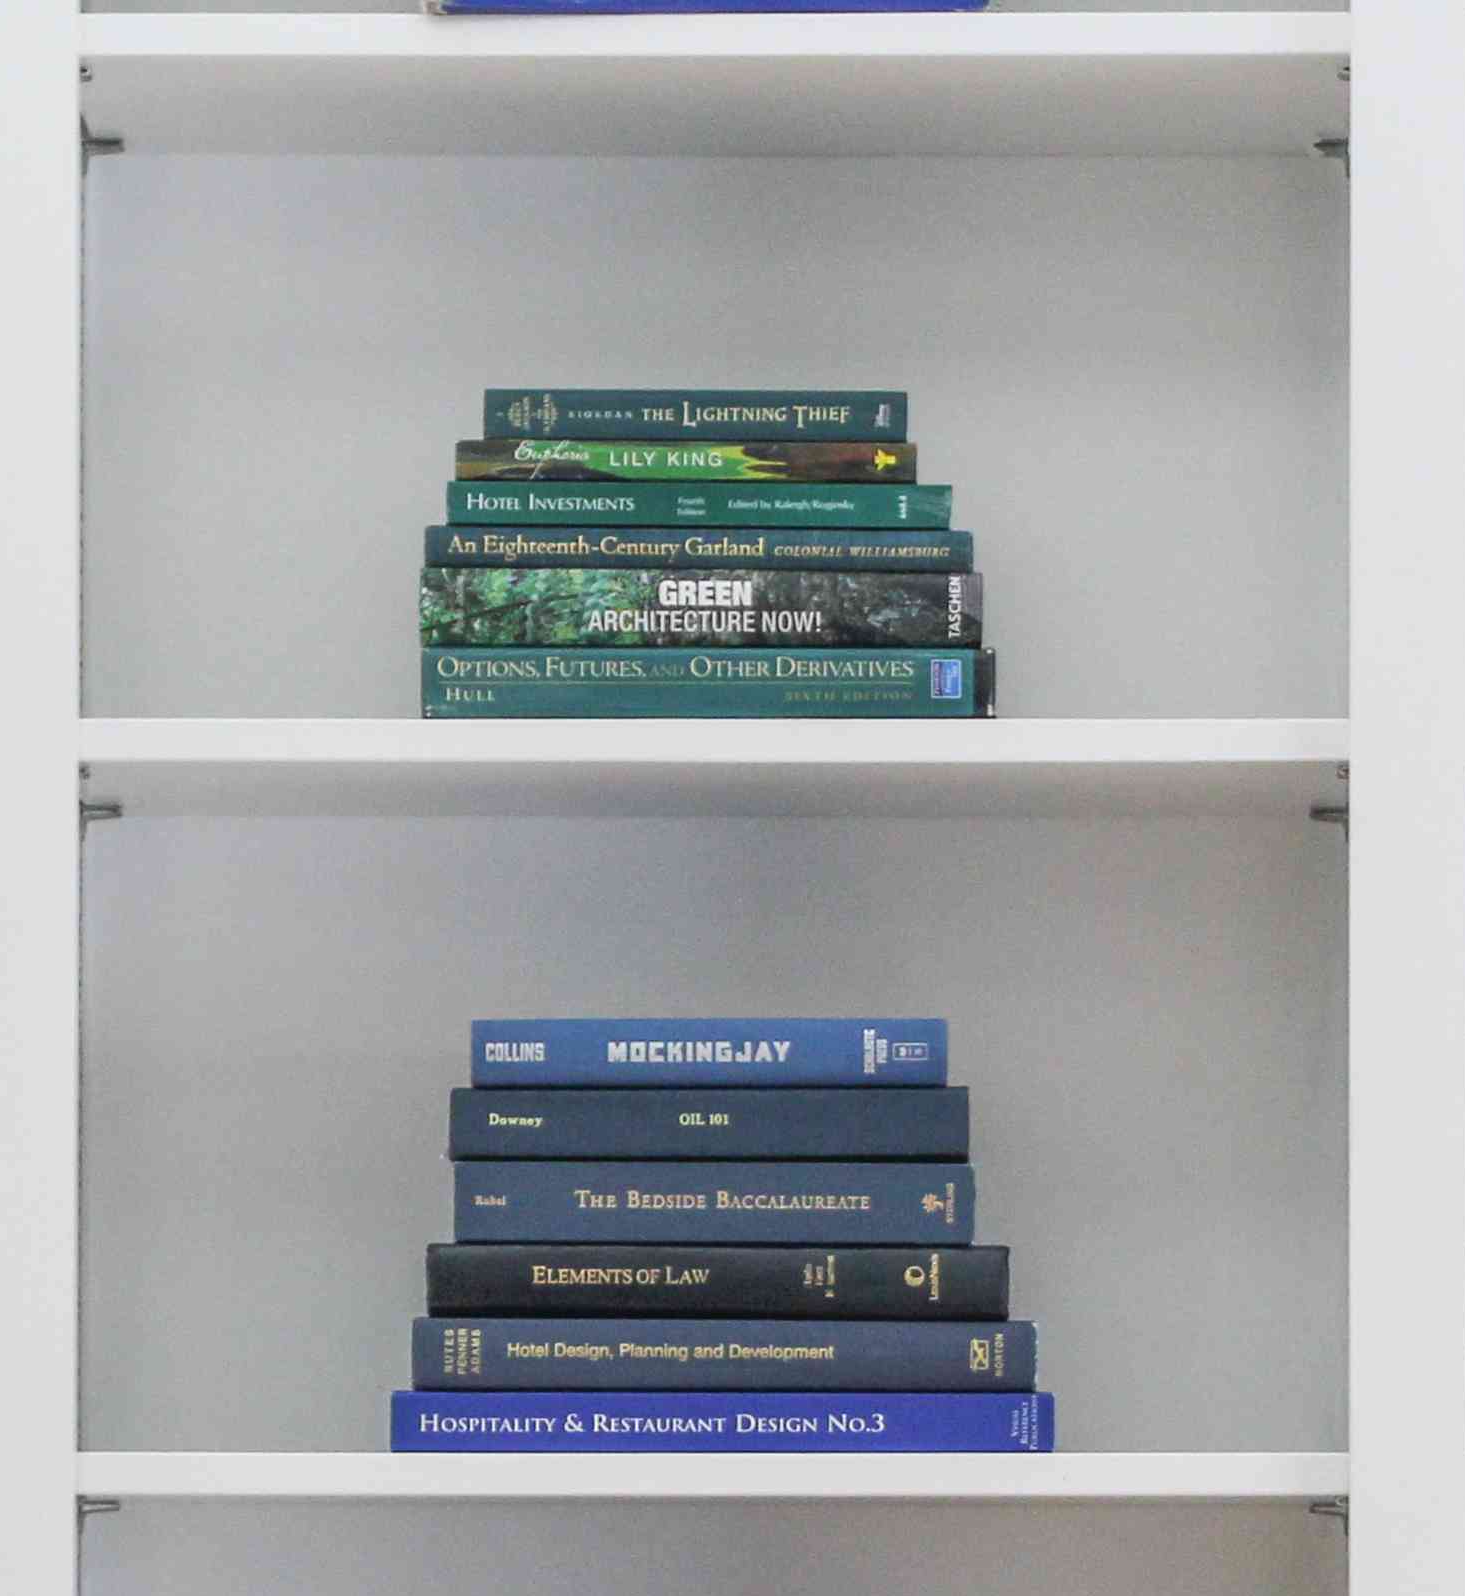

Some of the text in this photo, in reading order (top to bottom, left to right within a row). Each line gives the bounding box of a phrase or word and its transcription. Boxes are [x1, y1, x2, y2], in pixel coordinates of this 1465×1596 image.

[642, 408, 674, 421] THE
[683, 401, 787, 427] LIGHTNING
[793, 405, 850, 428] THIEF
[610, 452, 656, 467] LILY
[667, 452, 722, 467] KING
[448, 536, 951, 563] An Eighteenth-Century Garland COLONIAL WILLIAMSBURG
[659, 579, 752, 607] GREEN
[949, 576, 962, 638] TASCHEN
[588, 610, 821, 633] ARCHITECTURE NOW!
[690, 656, 770, 678] OTHER
[776, 656, 913, 677] DERIVATIVES
[446, 688, 496, 702] HULL
[485, 1040, 791, 1062] COLLINS MOCKINGJAY
[489, 1112, 729, 1127] Downey OIL 101
[575, 1190, 871, 1210] THE BEDSIDE BACCALAUREATE
[532, 1265, 710, 1285] ELEMENTS OF LAW
[507, 1342, 834, 1362] Hotel Design, Planning and Development
[994, 1332, 1004, 1377] NORTON
[420, 1412, 818, 1433] HOSPITALITY & RESTAURANT DESIGN
